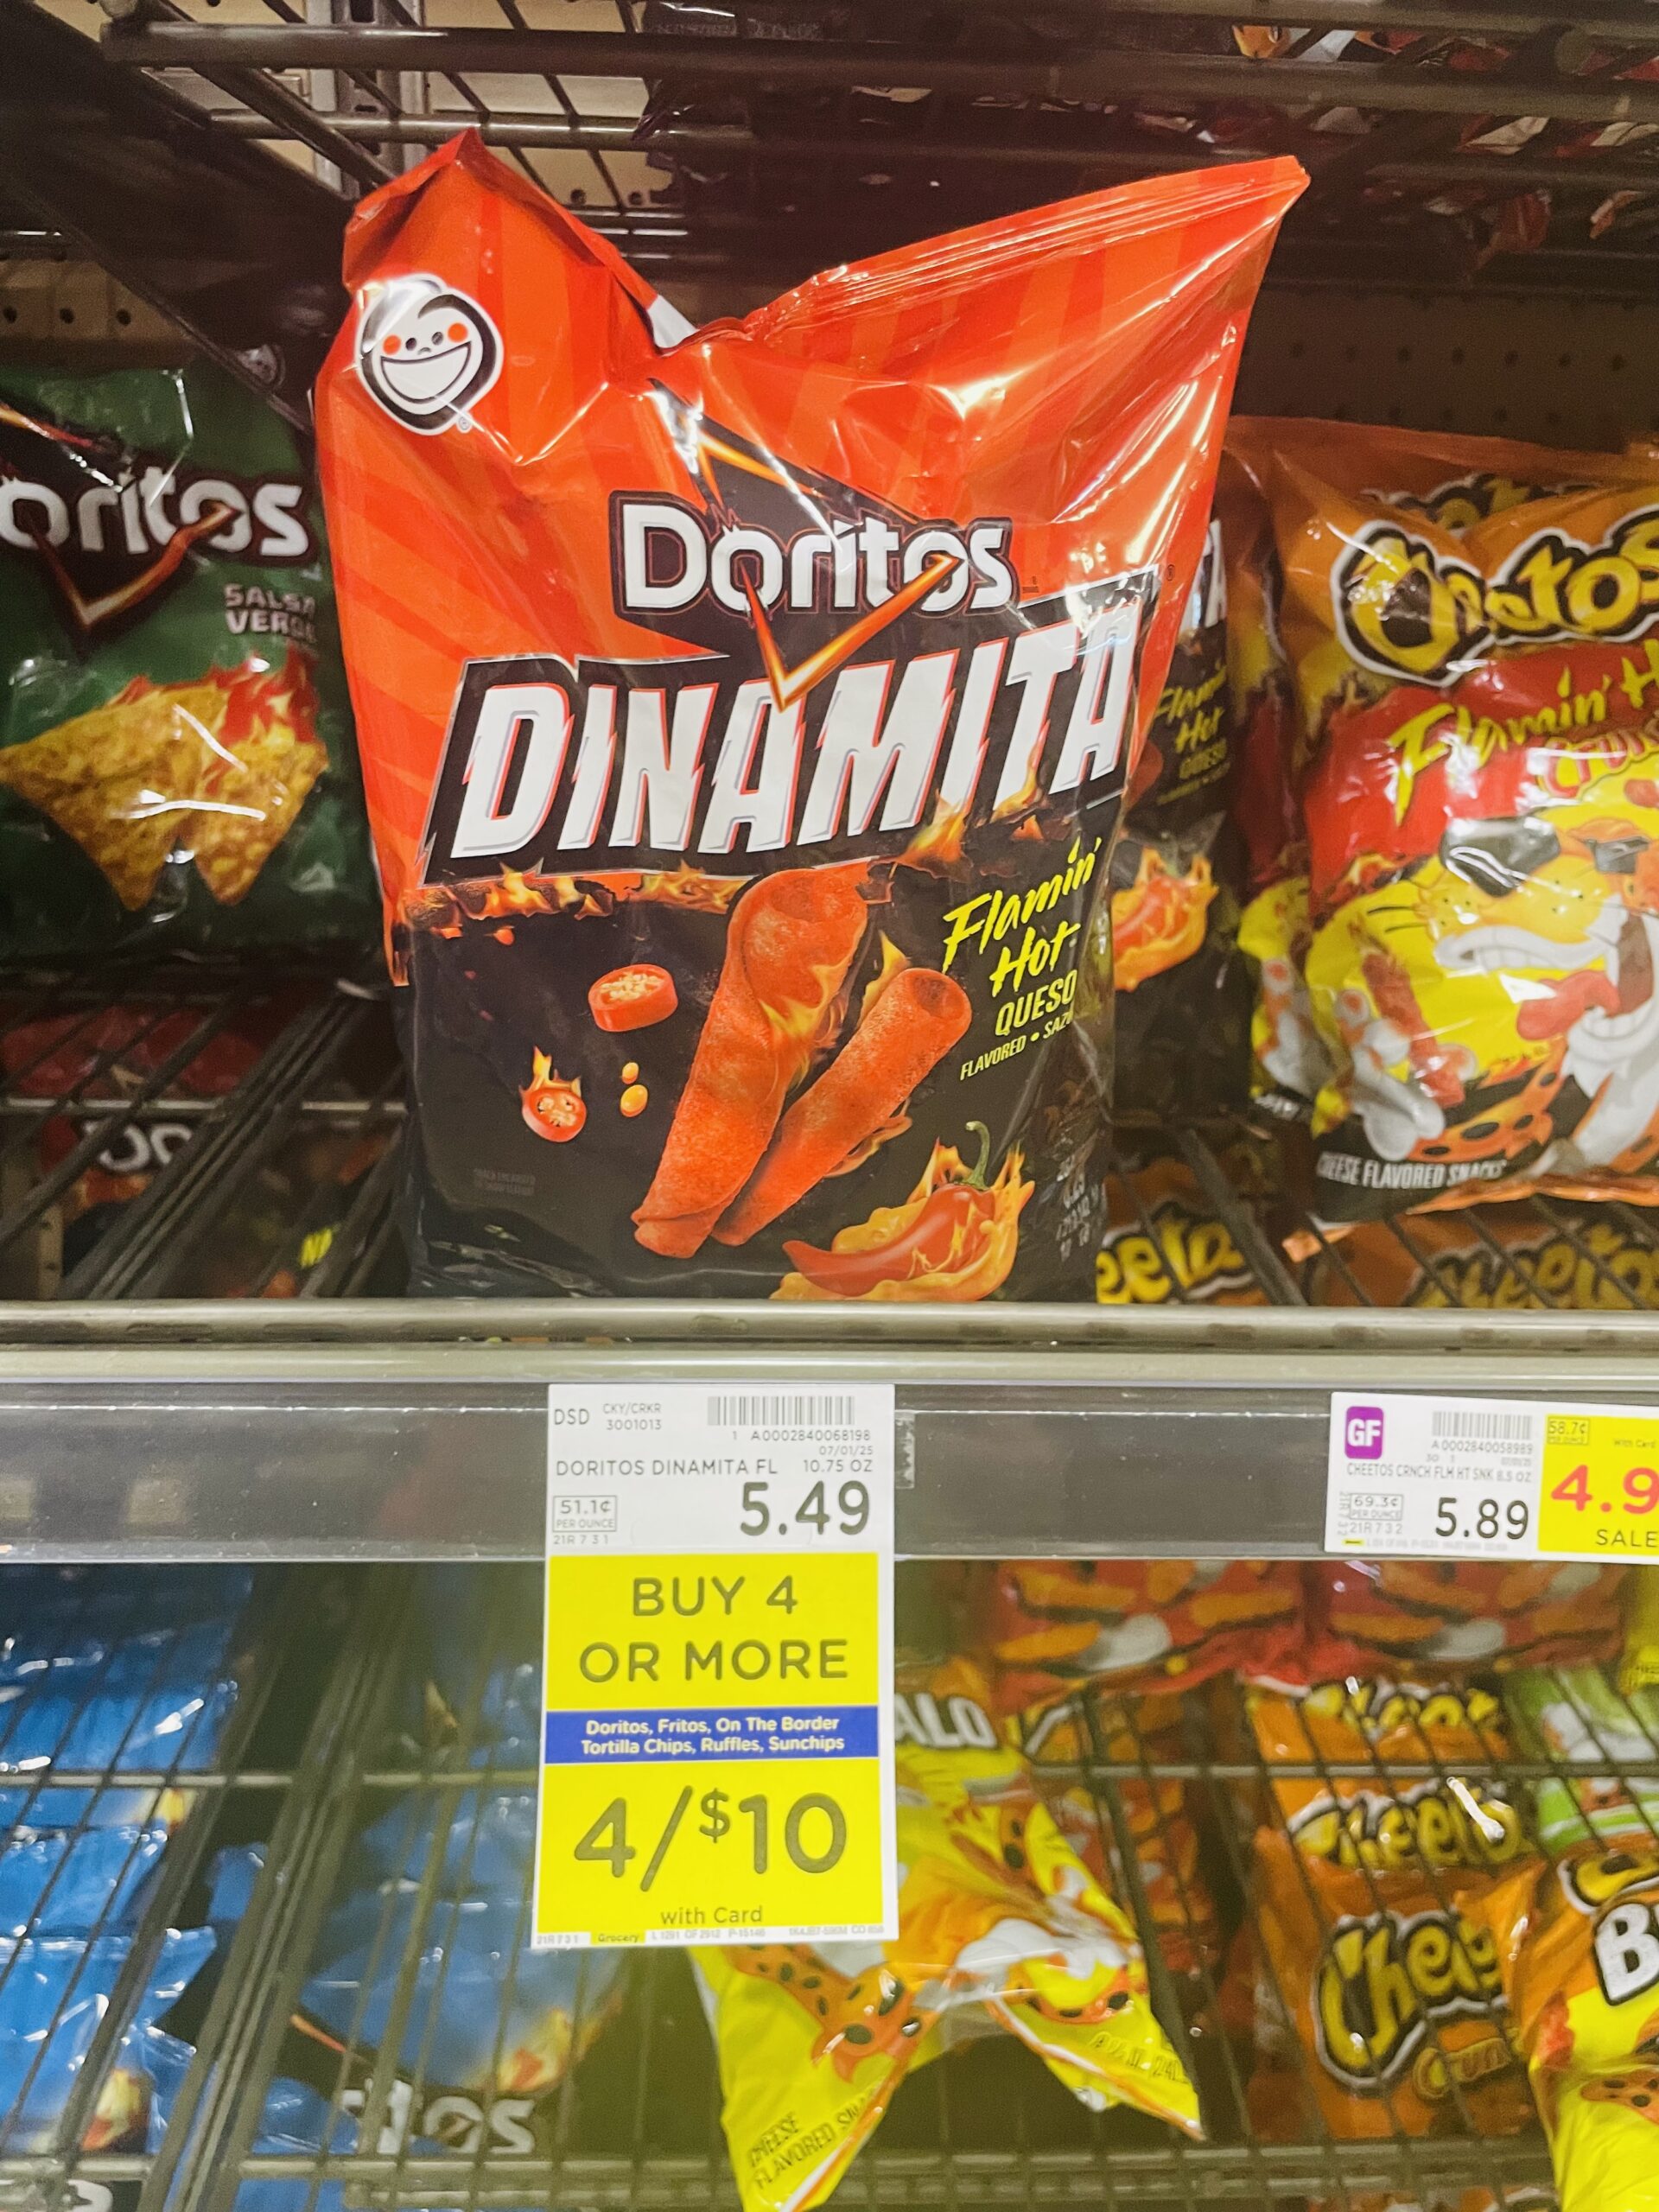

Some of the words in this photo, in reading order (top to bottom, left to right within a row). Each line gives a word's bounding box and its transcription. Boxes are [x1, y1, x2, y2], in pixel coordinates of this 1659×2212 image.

[623, 504, 1010, 613] Doritos
[225, 582, 315, 617] SALSA
[451, 598, 1141, 859] DINAMITA
[943, 836, 1102, 974] Flamin'
[989, 921, 1080, 997] Hot
[995, 969, 1077, 1036] QUESO
[960, 1035, 1027, 1080] FLAVORED
[1363, 1160, 1446, 1189] FLAVORED
[554, 1408, 589, 1426] DSD
[603, 1402, 661, 1415] CKY/CRKR
[607, 1420, 661, 1430] 3001013
[1347, 1419, 1381, 1446] GF
[819, 1446, 873, 1456] 07/01/25
[556, 1460, 645, 1476] DORITOS
[652, 1459, 748, 1475] DINAMITA
[756, 1459, 778, 1474] FL
[804, 1459, 843, 1472] 10.75
[850, 1459, 873, 1472] OZ
[1347, 1463, 1393, 1477] CHEETOS
[1396, 1465, 1431, 1478] CRNCH
[1516, 1471, 1531, 1483] OZ
[560, 1500, 611, 1514] 51.1¢
[741, 1480, 870, 1535] 5.49
[1435, 1497, 1529, 1539] 5.89
[556, 1519, 575, 1528] PER
[579, 1519, 614, 1528] OUNCE
[1596, 1529, 1658, 1547] SALE
[633, 1576, 744, 1617] BUY
[766, 1576, 798, 1614] 4
[580, 1642, 658, 1682] OR
[685, 1639, 848, 1680] MORE
[586, 1720, 652, 1736] Doritos,
[658, 1719, 711, 1734] Fritos,
[716, 1718, 741, 1732] On
[746, 1717, 777, 1732] The
[781, 1716, 839, 1731] Border
[582, 1738, 639, 1754] Tortilla
[644, 1738, 696, 1755] Chips,
[701, 1737, 764, 1752] Ruffles,
[769, 1736, 845, 1751] Sunchips
[661, 1907, 705, 1925] with
[714, 1905, 762, 1923] Card
[598, 1934, 639, 1943] Grocery
